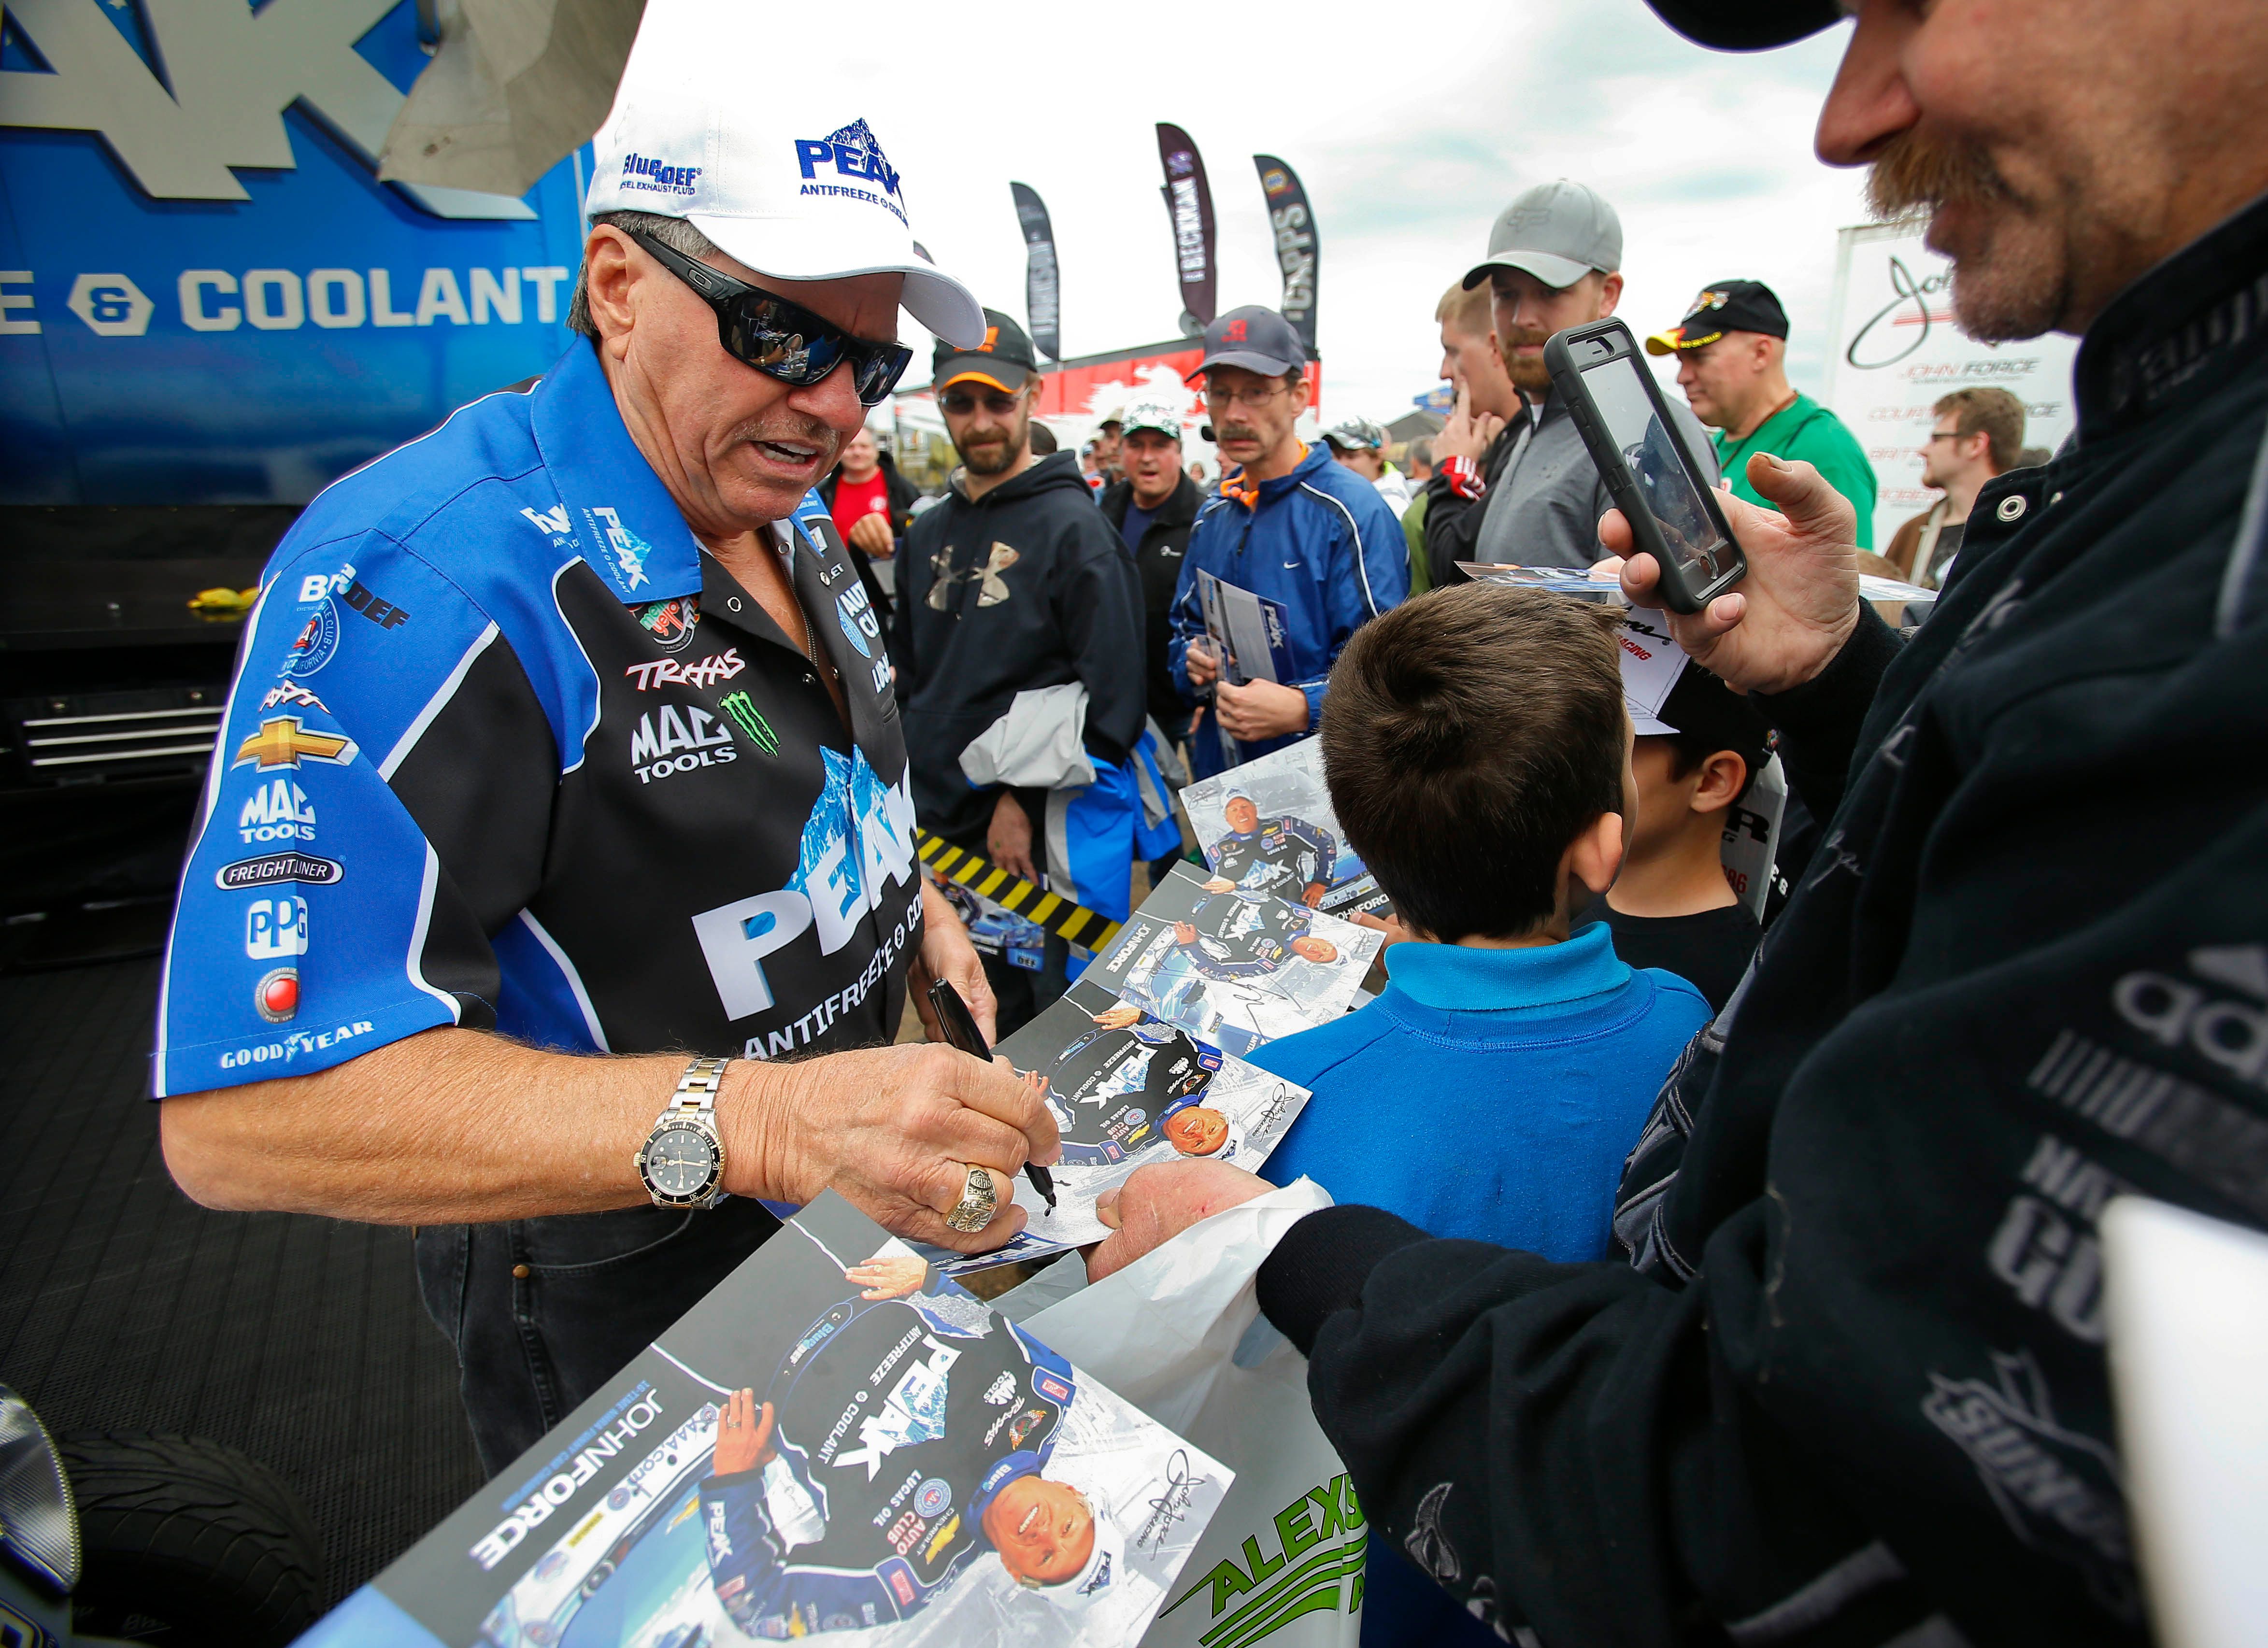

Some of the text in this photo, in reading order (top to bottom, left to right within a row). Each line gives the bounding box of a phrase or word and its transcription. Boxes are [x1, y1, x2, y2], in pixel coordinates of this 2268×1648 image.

[795, 139, 906, 216] PEAK
[800, 184, 879, 204] ANTIFREEZE
[178, 267, 568, 331] COOLANT
[581, 508, 631, 594] ANTIFREEZE COOLANT
[592, 507, 651, 591] PEAK
[653, 600, 684, 637] yello
[1264, 604, 1284, 649] PEAK
[631, 704, 733, 767] MAC
[634, 746, 737, 784] TOOLS
[240, 779, 316, 828] MAC
[240, 823, 316, 844] TOOLS
[228, 858, 328, 883] FREIGHTLINER
[691, 757, 918, 1021] PEAK
[1276, 872, 1296, 888] COOLANT
[249, 899, 307, 952] PPG
[1225, 902, 1266, 941] PEAK
[1105, 923, 1152, 974] JOHNFORCE
[744, 938, 894, 1060] ANTIFREEZE
[1079, 1043, 1158, 1110] PEAK
[1103, 1039, 1135, 1069] ANTIFREEZE
[1071, 1076, 1097, 1102] COOLANT
[1112, 1105, 1130, 1120] LUCAS
[1106, 1120, 1125, 1137] CLUB
[1112, 1124, 1130, 1141] AUTO
[1252, 1117, 1266, 1138] RACING
[713, 1162, 720, 1170] 20
[869, 1325, 922, 1386] ANTIFREEZE
[832, 1333, 962, 1482] PEAK
[984, 1370, 1011, 1403] TOOLS
[818, 1403, 859, 1464] COOLANT
[984, 1395, 1024, 1448] TRAXXAS
[469, 1388, 664, 1571] JOHNFORCE
[873, 1469, 922, 1526] LUCAS OIL
[708, 1501, 733, 1566] PEAK
[887, 1510, 916, 1544] CLUB
[896, 1518, 926, 1555] AUTO
[918, 1507, 955, 1556] CHEVROLET
[1137, 1511, 1161, 1549] RACING
[1076, 1550, 1113, 1597] PEAK
